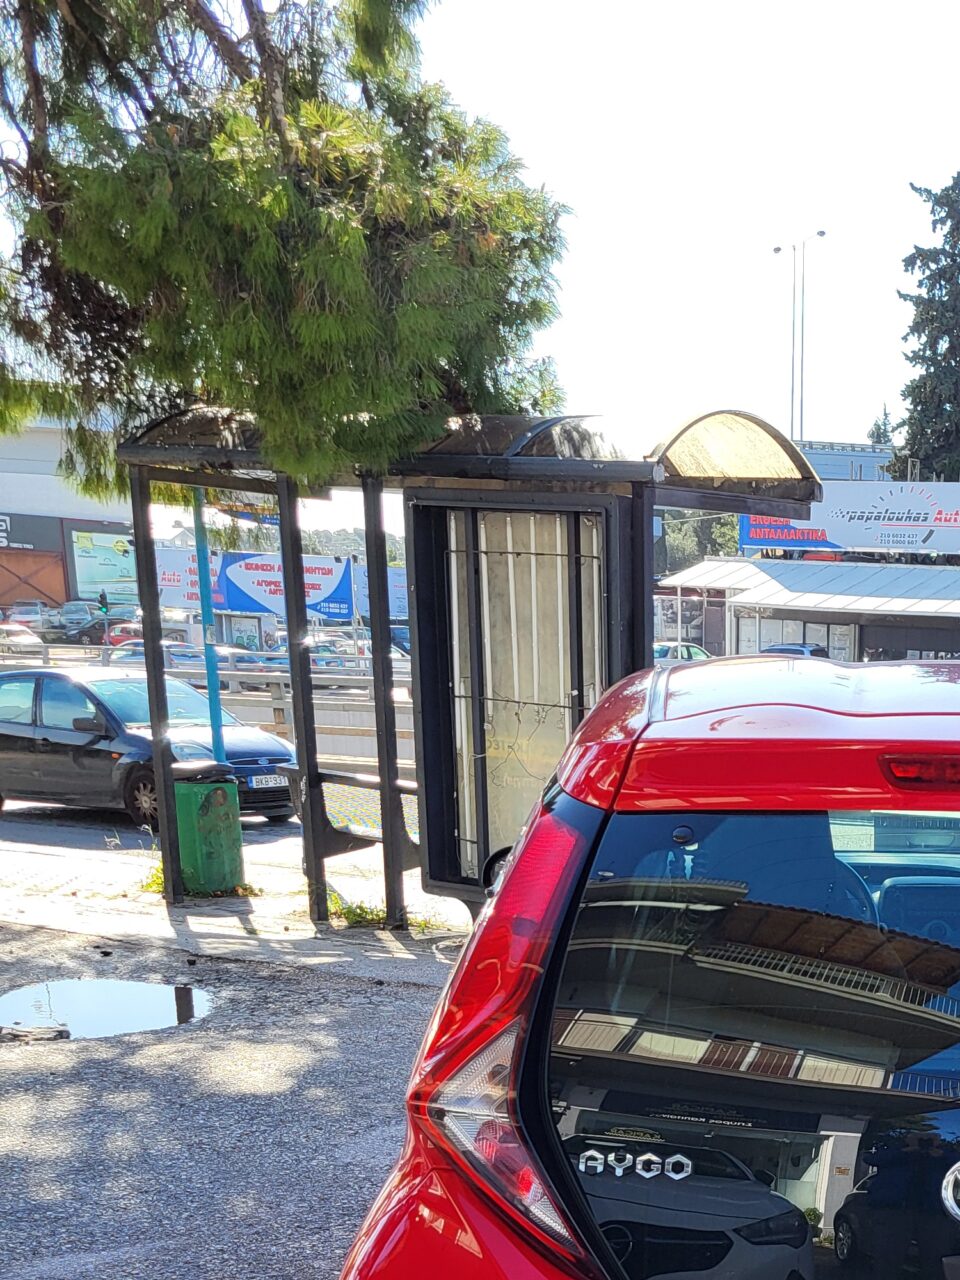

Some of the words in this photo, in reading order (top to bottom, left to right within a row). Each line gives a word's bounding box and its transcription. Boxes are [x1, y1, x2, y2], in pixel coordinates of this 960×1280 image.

[847, 508, 930, 523] papaloukas
[750, 528, 828, 541] ΑΝΤΑΛΛΑΚΤΙΚΑ
[161, 570, 182, 583] Auto
[255, 775, 288, 787] BKB-931
[578, 1149, 692, 1181] AYGO
